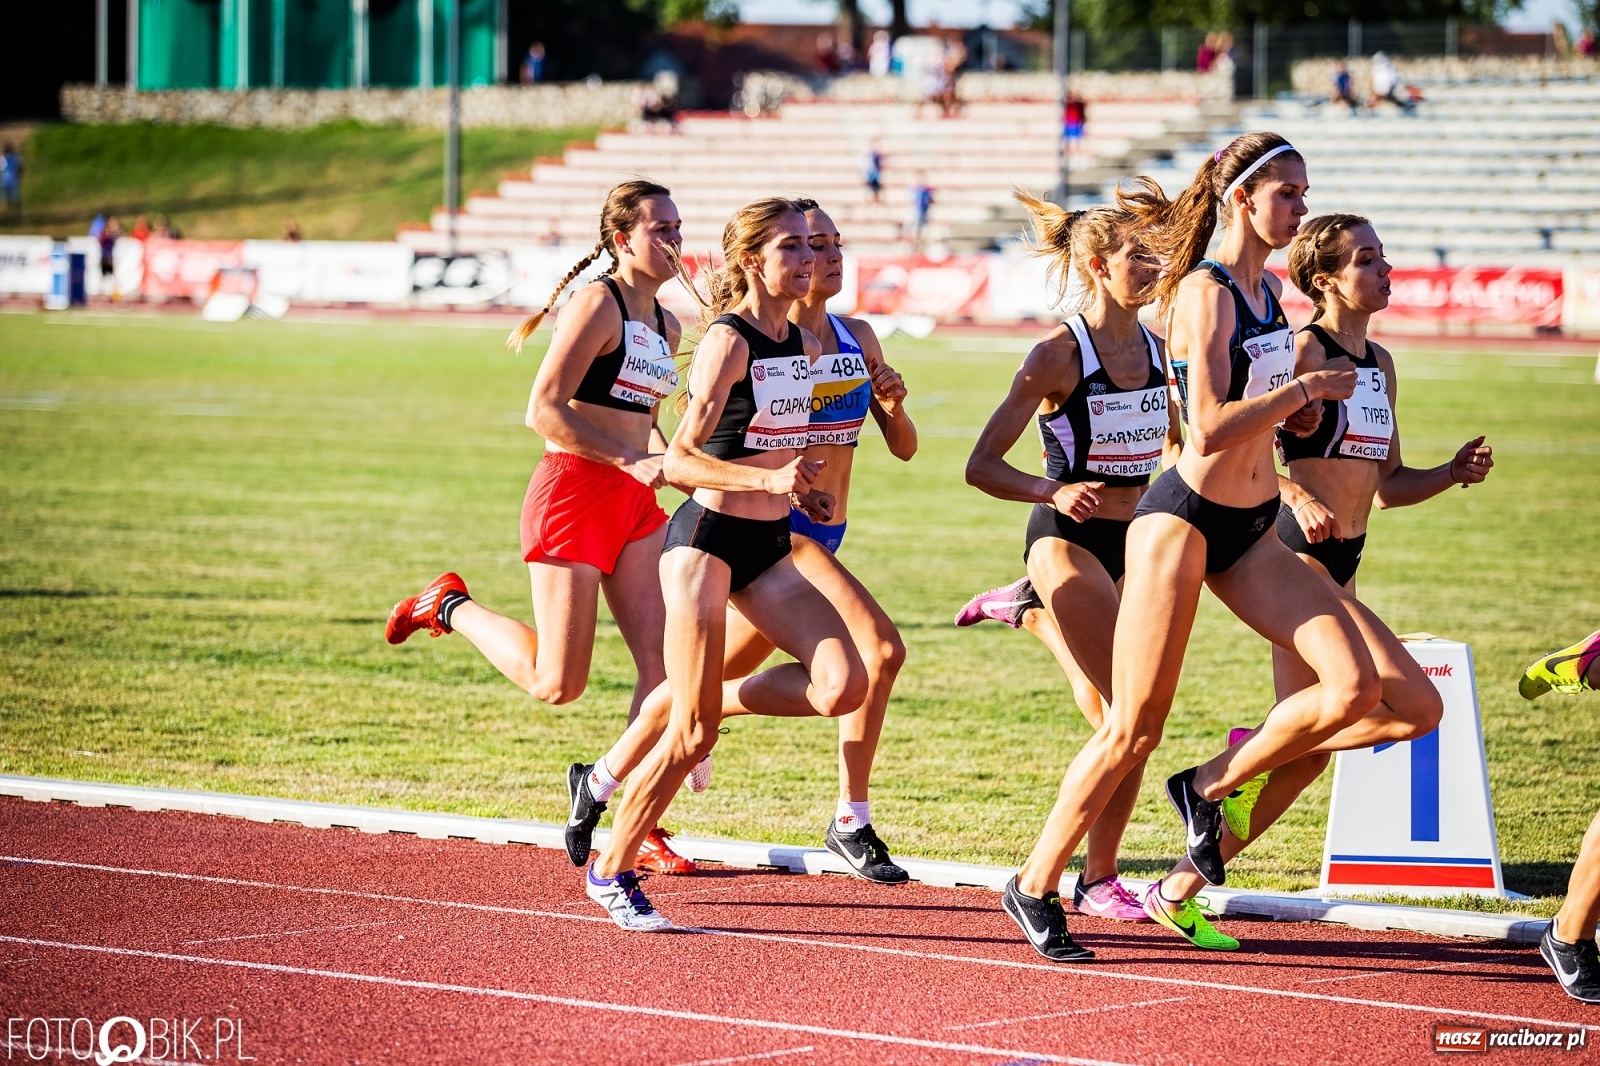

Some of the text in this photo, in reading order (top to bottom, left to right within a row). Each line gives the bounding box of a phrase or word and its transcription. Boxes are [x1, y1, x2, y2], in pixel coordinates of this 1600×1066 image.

[831, 357, 865, 378] 484
[1140, 390, 1167, 413] 662
[1361, 406, 1390, 426] TYPER
[756, 435, 795, 448] RACIBÓRZ
[1097, 463, 1143, 474] RACIBÓRZ
